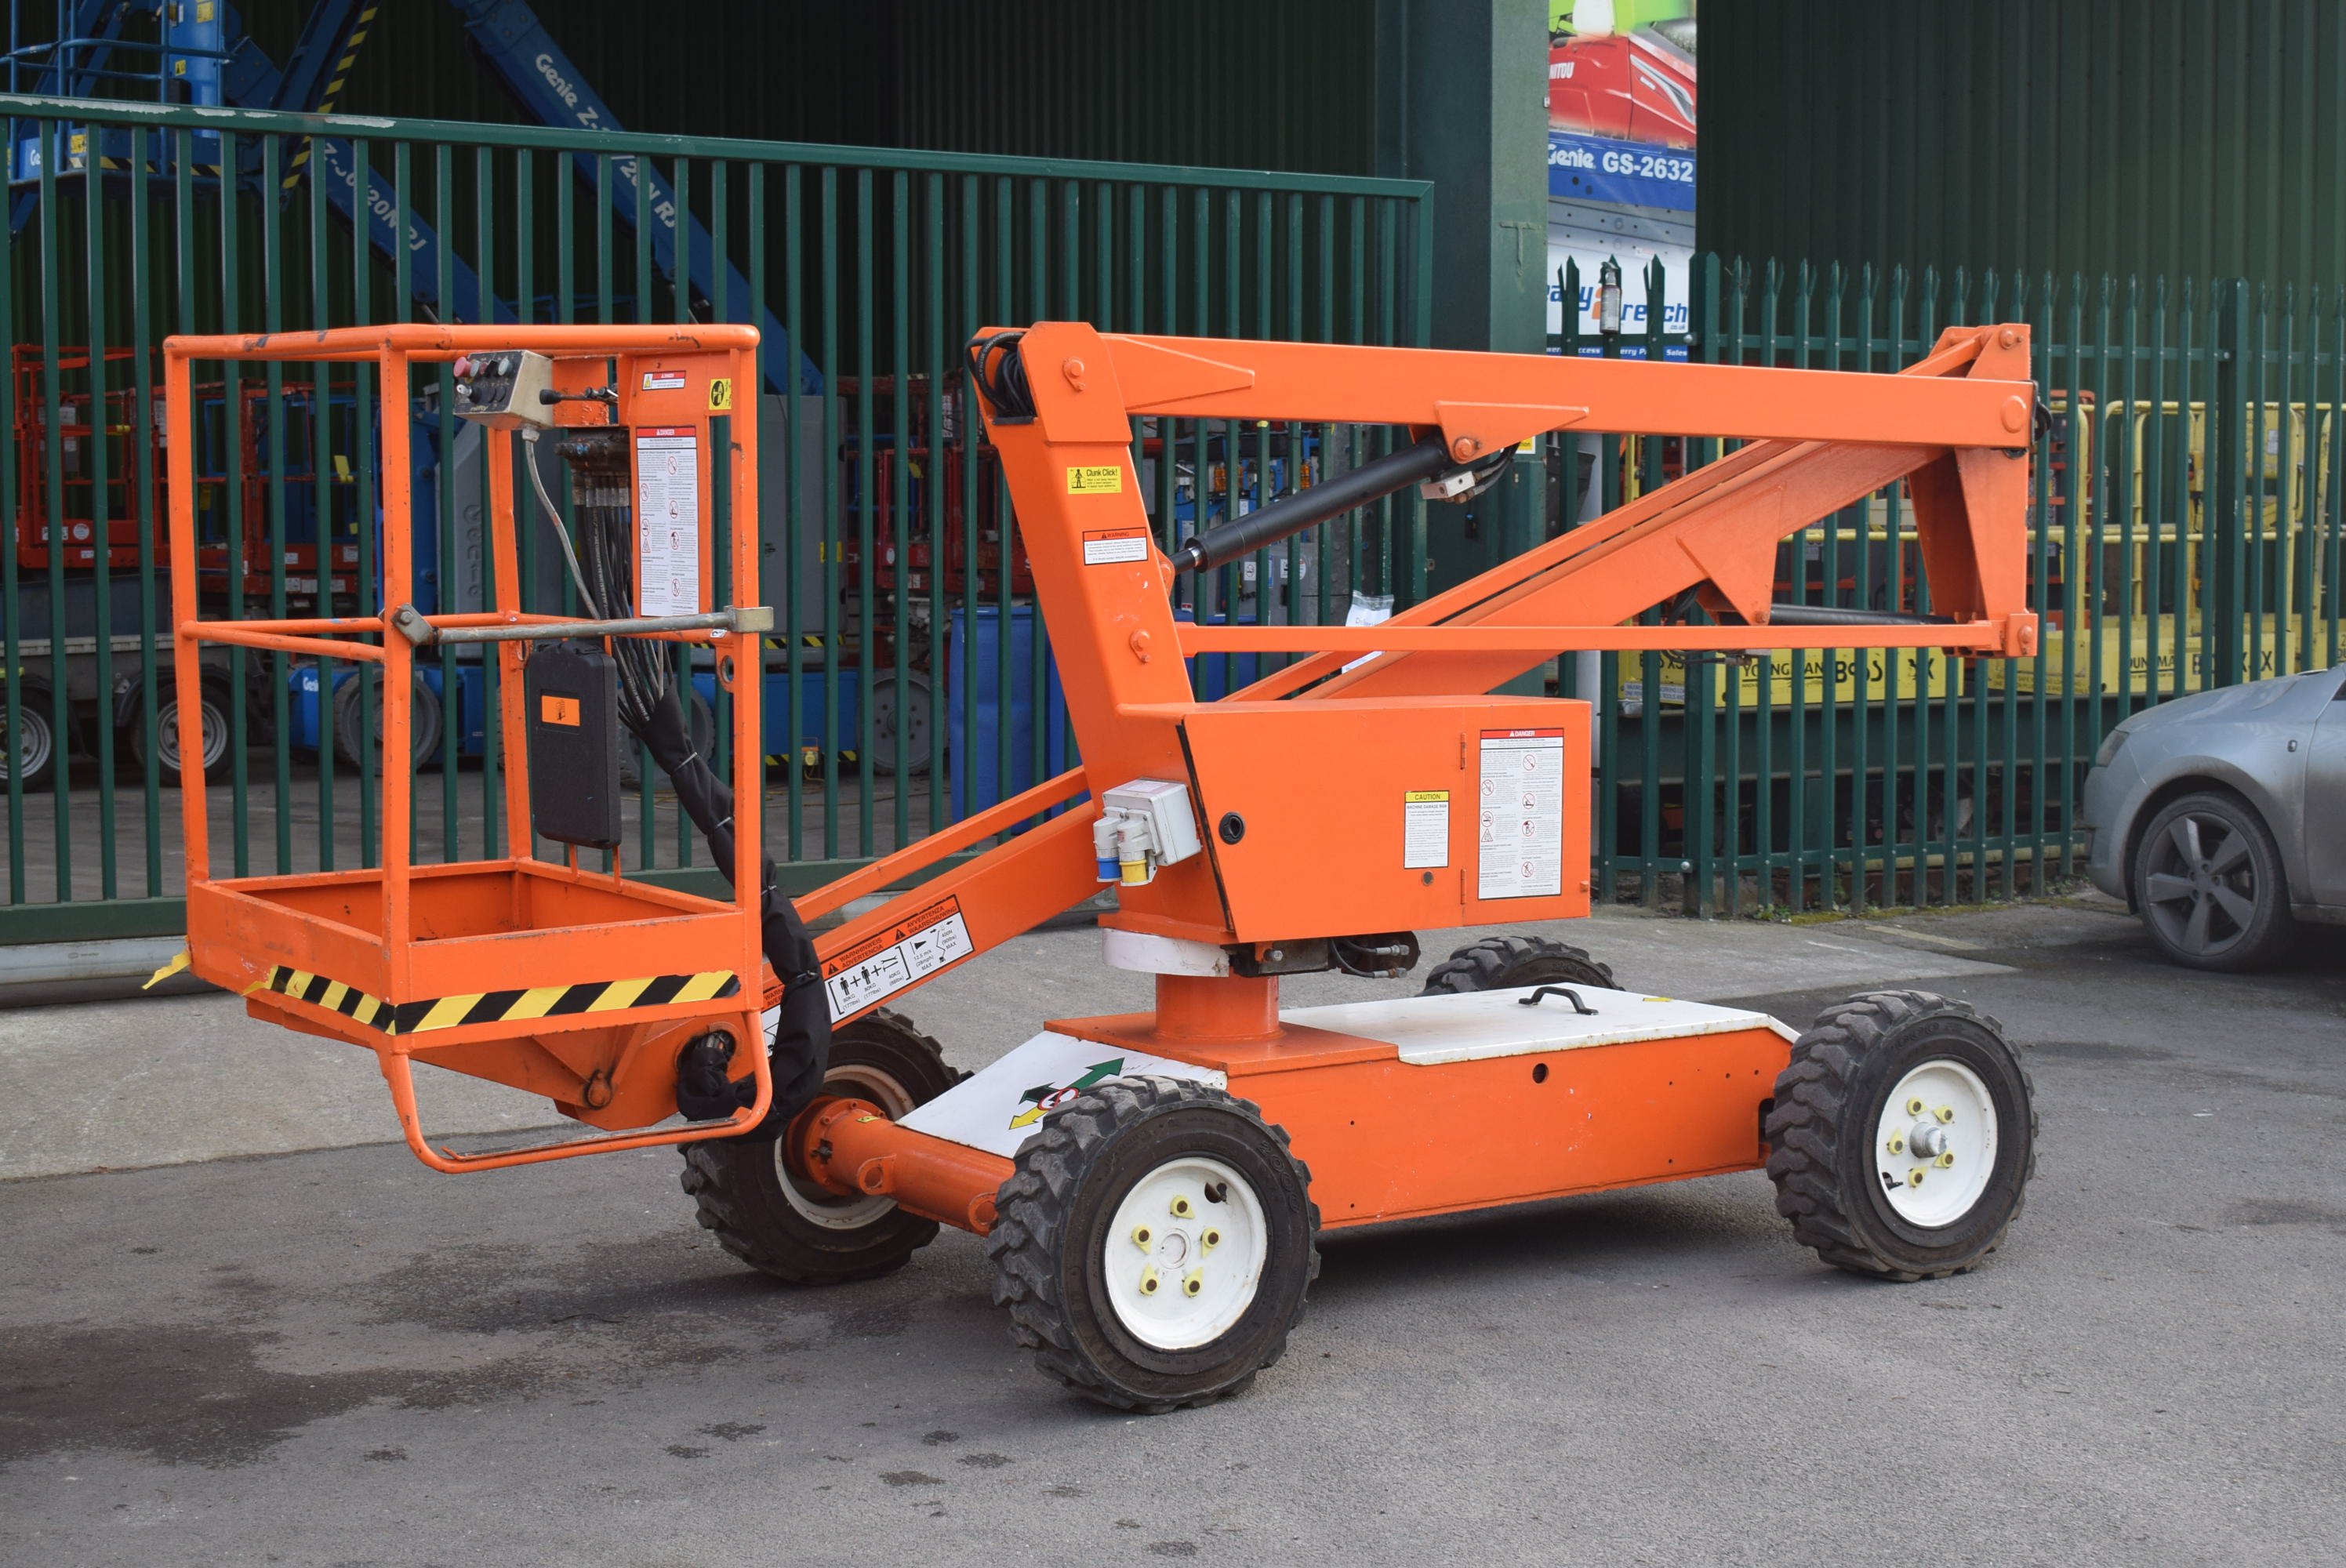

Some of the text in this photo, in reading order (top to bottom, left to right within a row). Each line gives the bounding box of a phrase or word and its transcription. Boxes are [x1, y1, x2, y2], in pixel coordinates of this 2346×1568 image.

[536, 54, 578, 107] Genie
[1548, 143, 1694, 183] Genie GS-2632
[1102, 468, 1118, 477] Click!
[303, 677, 320, 691] Geni
[906, 906, 945, 928] AVVERTENZA
[908, 906, 957, 934] WAARSCHUWING
[840, 938, 883, 962] WARNHINWEIS
[841, 944, 884, 967] ADVERTENCIA
[764, 988, 784, 1000] WARN
